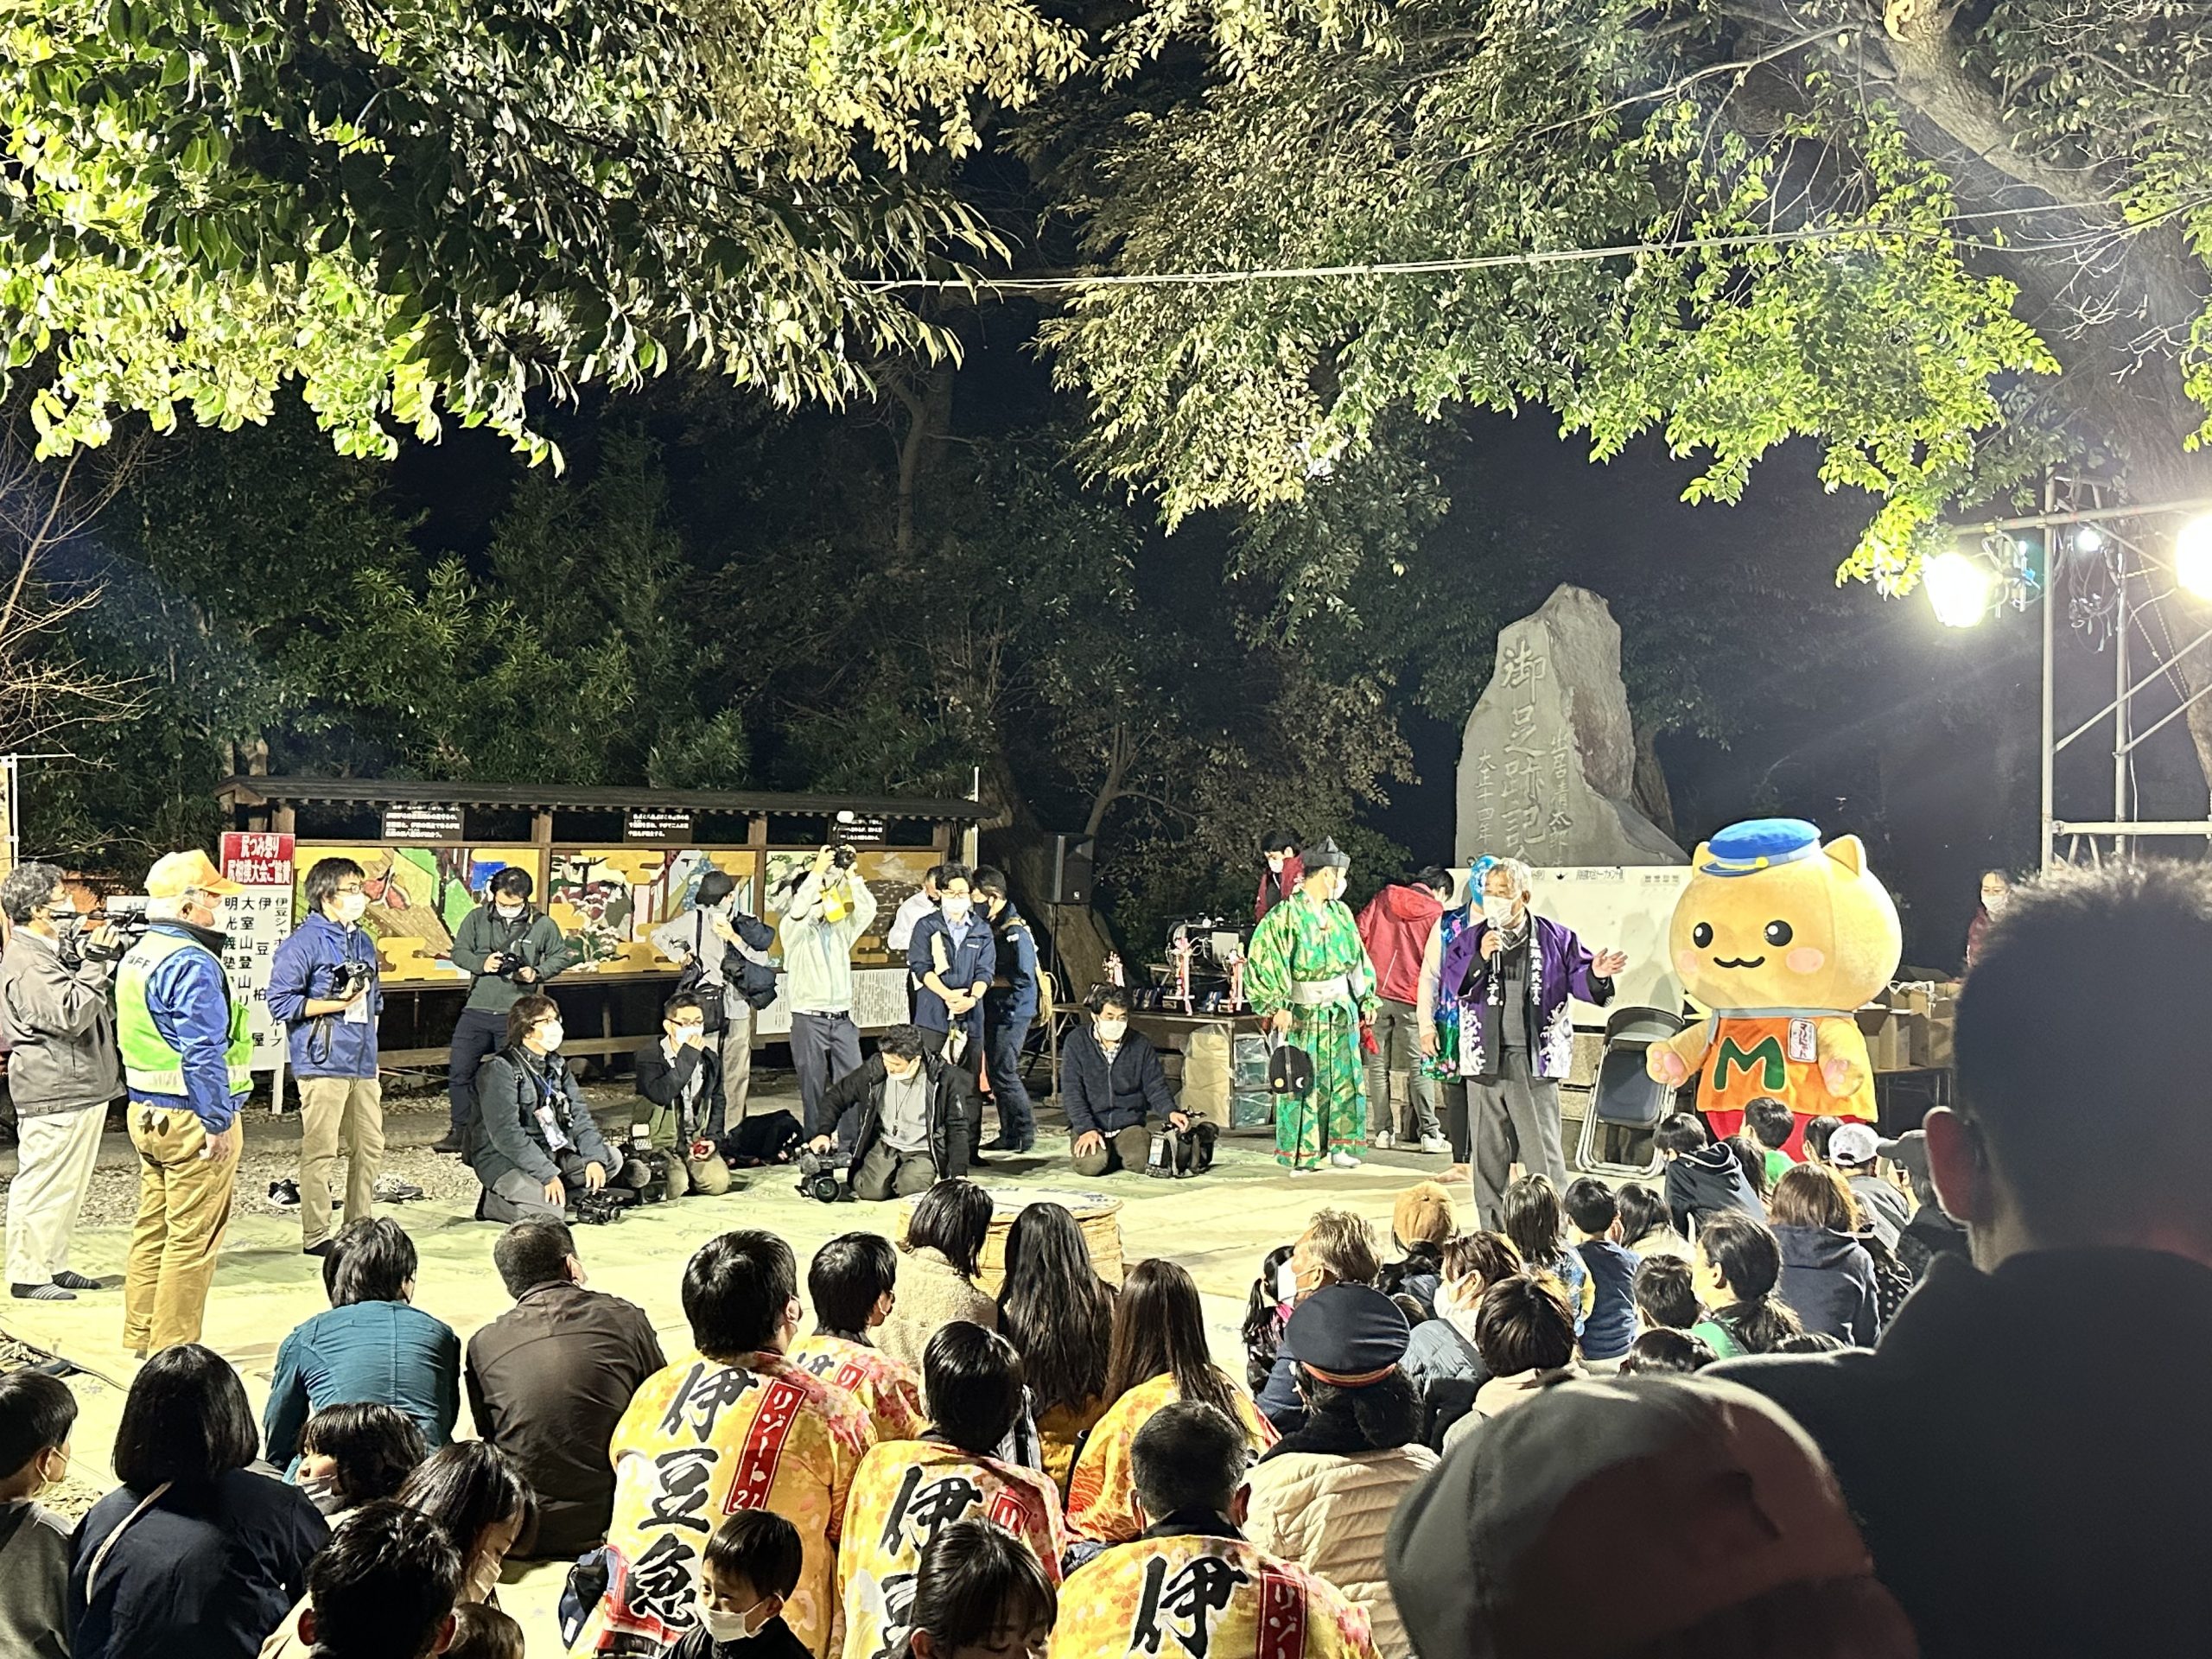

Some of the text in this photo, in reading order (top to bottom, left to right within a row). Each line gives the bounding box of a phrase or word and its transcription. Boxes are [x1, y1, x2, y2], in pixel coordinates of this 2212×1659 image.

[227, 860, 290, 883] 尻相撲大会ご協賛
[241, 836, 279, 858] 尻つみ祭り
[223, 897, 238, 983] 明光義塾
[252, 897, 272, 1047] 伊豆柏屋
[1713, 1036, 1785, 1090] M
[629, 1362, 760, 1628] 伊豆急
[732, 1389, 793, 1511] リゾート21
[1127, 1556, 1249, 1659] 伊
